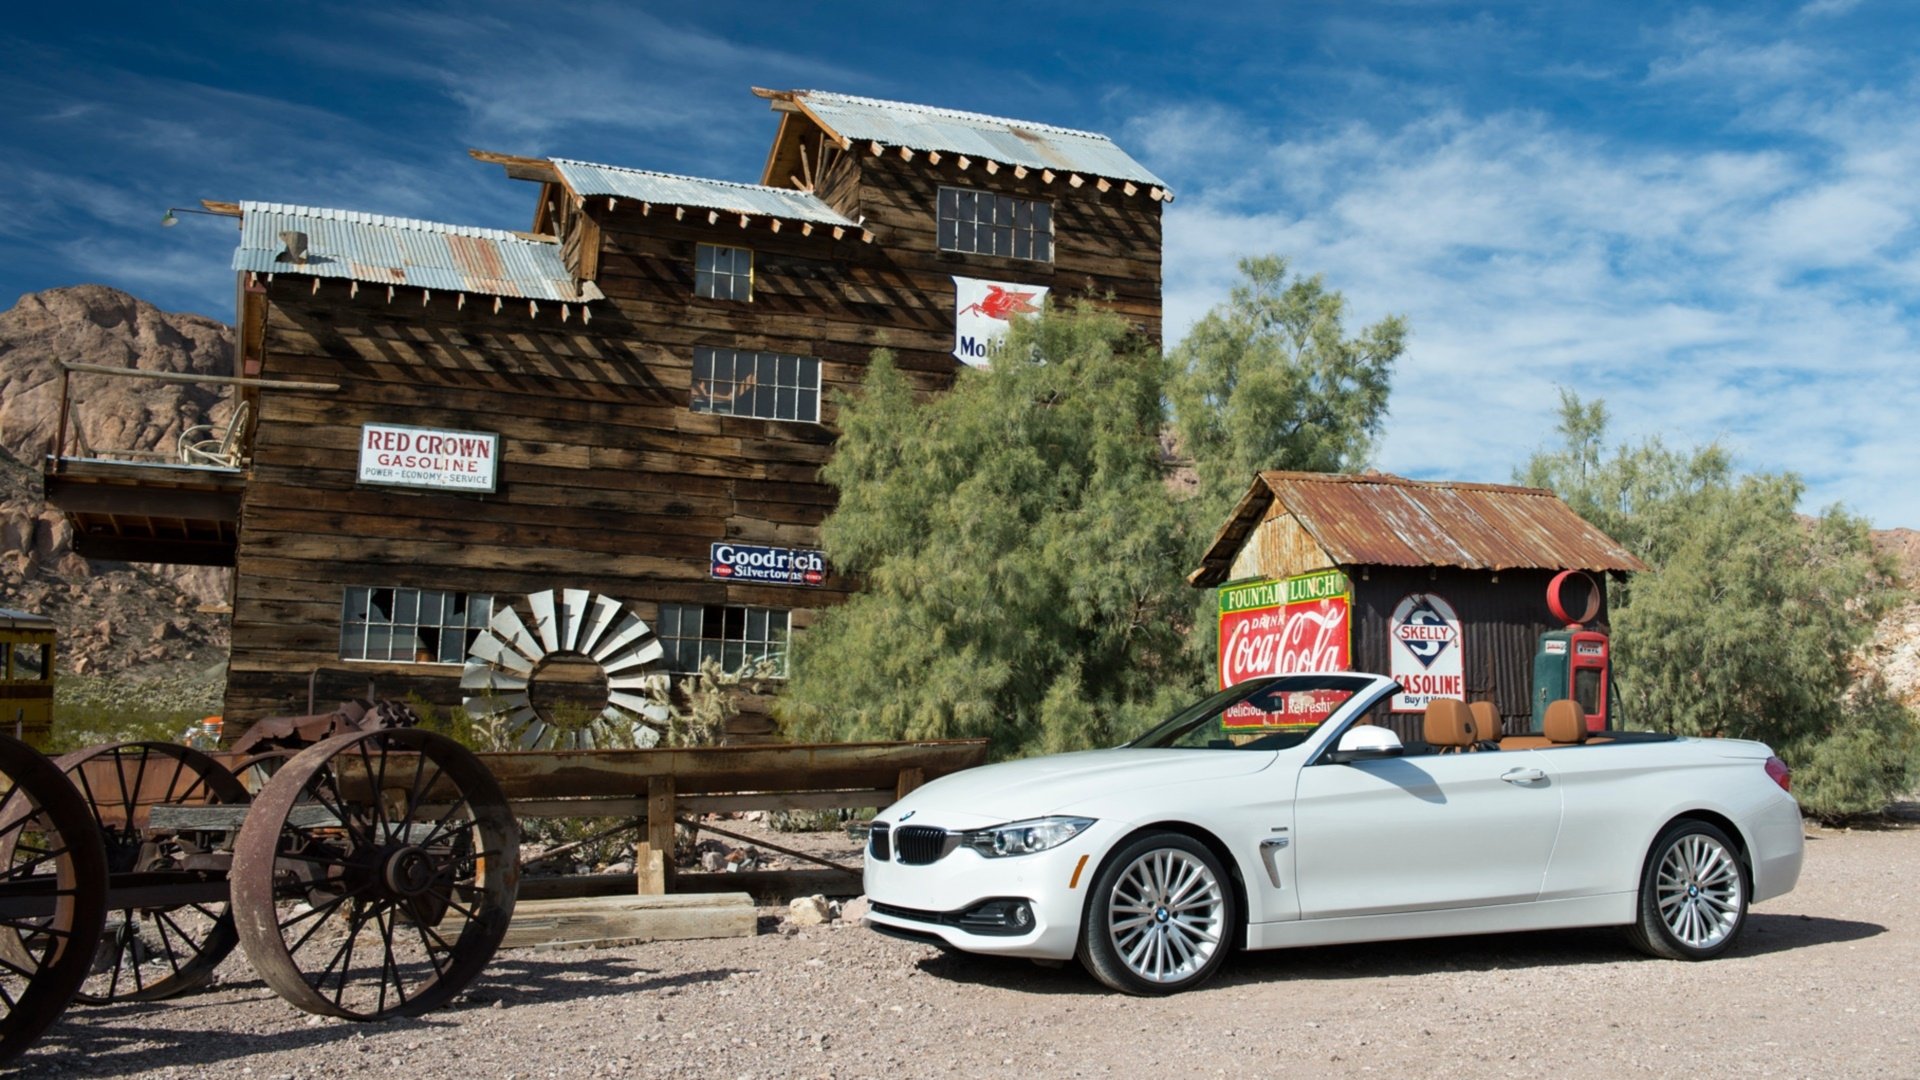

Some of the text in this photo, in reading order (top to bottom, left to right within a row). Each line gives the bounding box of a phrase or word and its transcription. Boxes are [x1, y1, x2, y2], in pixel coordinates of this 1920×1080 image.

[367, 430, 490, 459] RED CROWN
[377, 453, 478, 473] GASOLINE
[365, 467, 393, 477] POWER
[401, 470, 441, 480] ECONOMY
[449, 473, 488, 484] SERVICE
[716, 546, 822, 571] Goodrich
[734, 564, 802, 580] Silvertowns
[1228, 575, 1336, 609] FOUNTAIN LUNCH
[1251, 615, 1285, 630] DRINK
[1401, 626, 1448, 640] SKELLY
[1288, 697, 1334, 714] Refreshi
[1404, 695, 1420, 707] Buy
[1423, 695, 1430, 704] it
